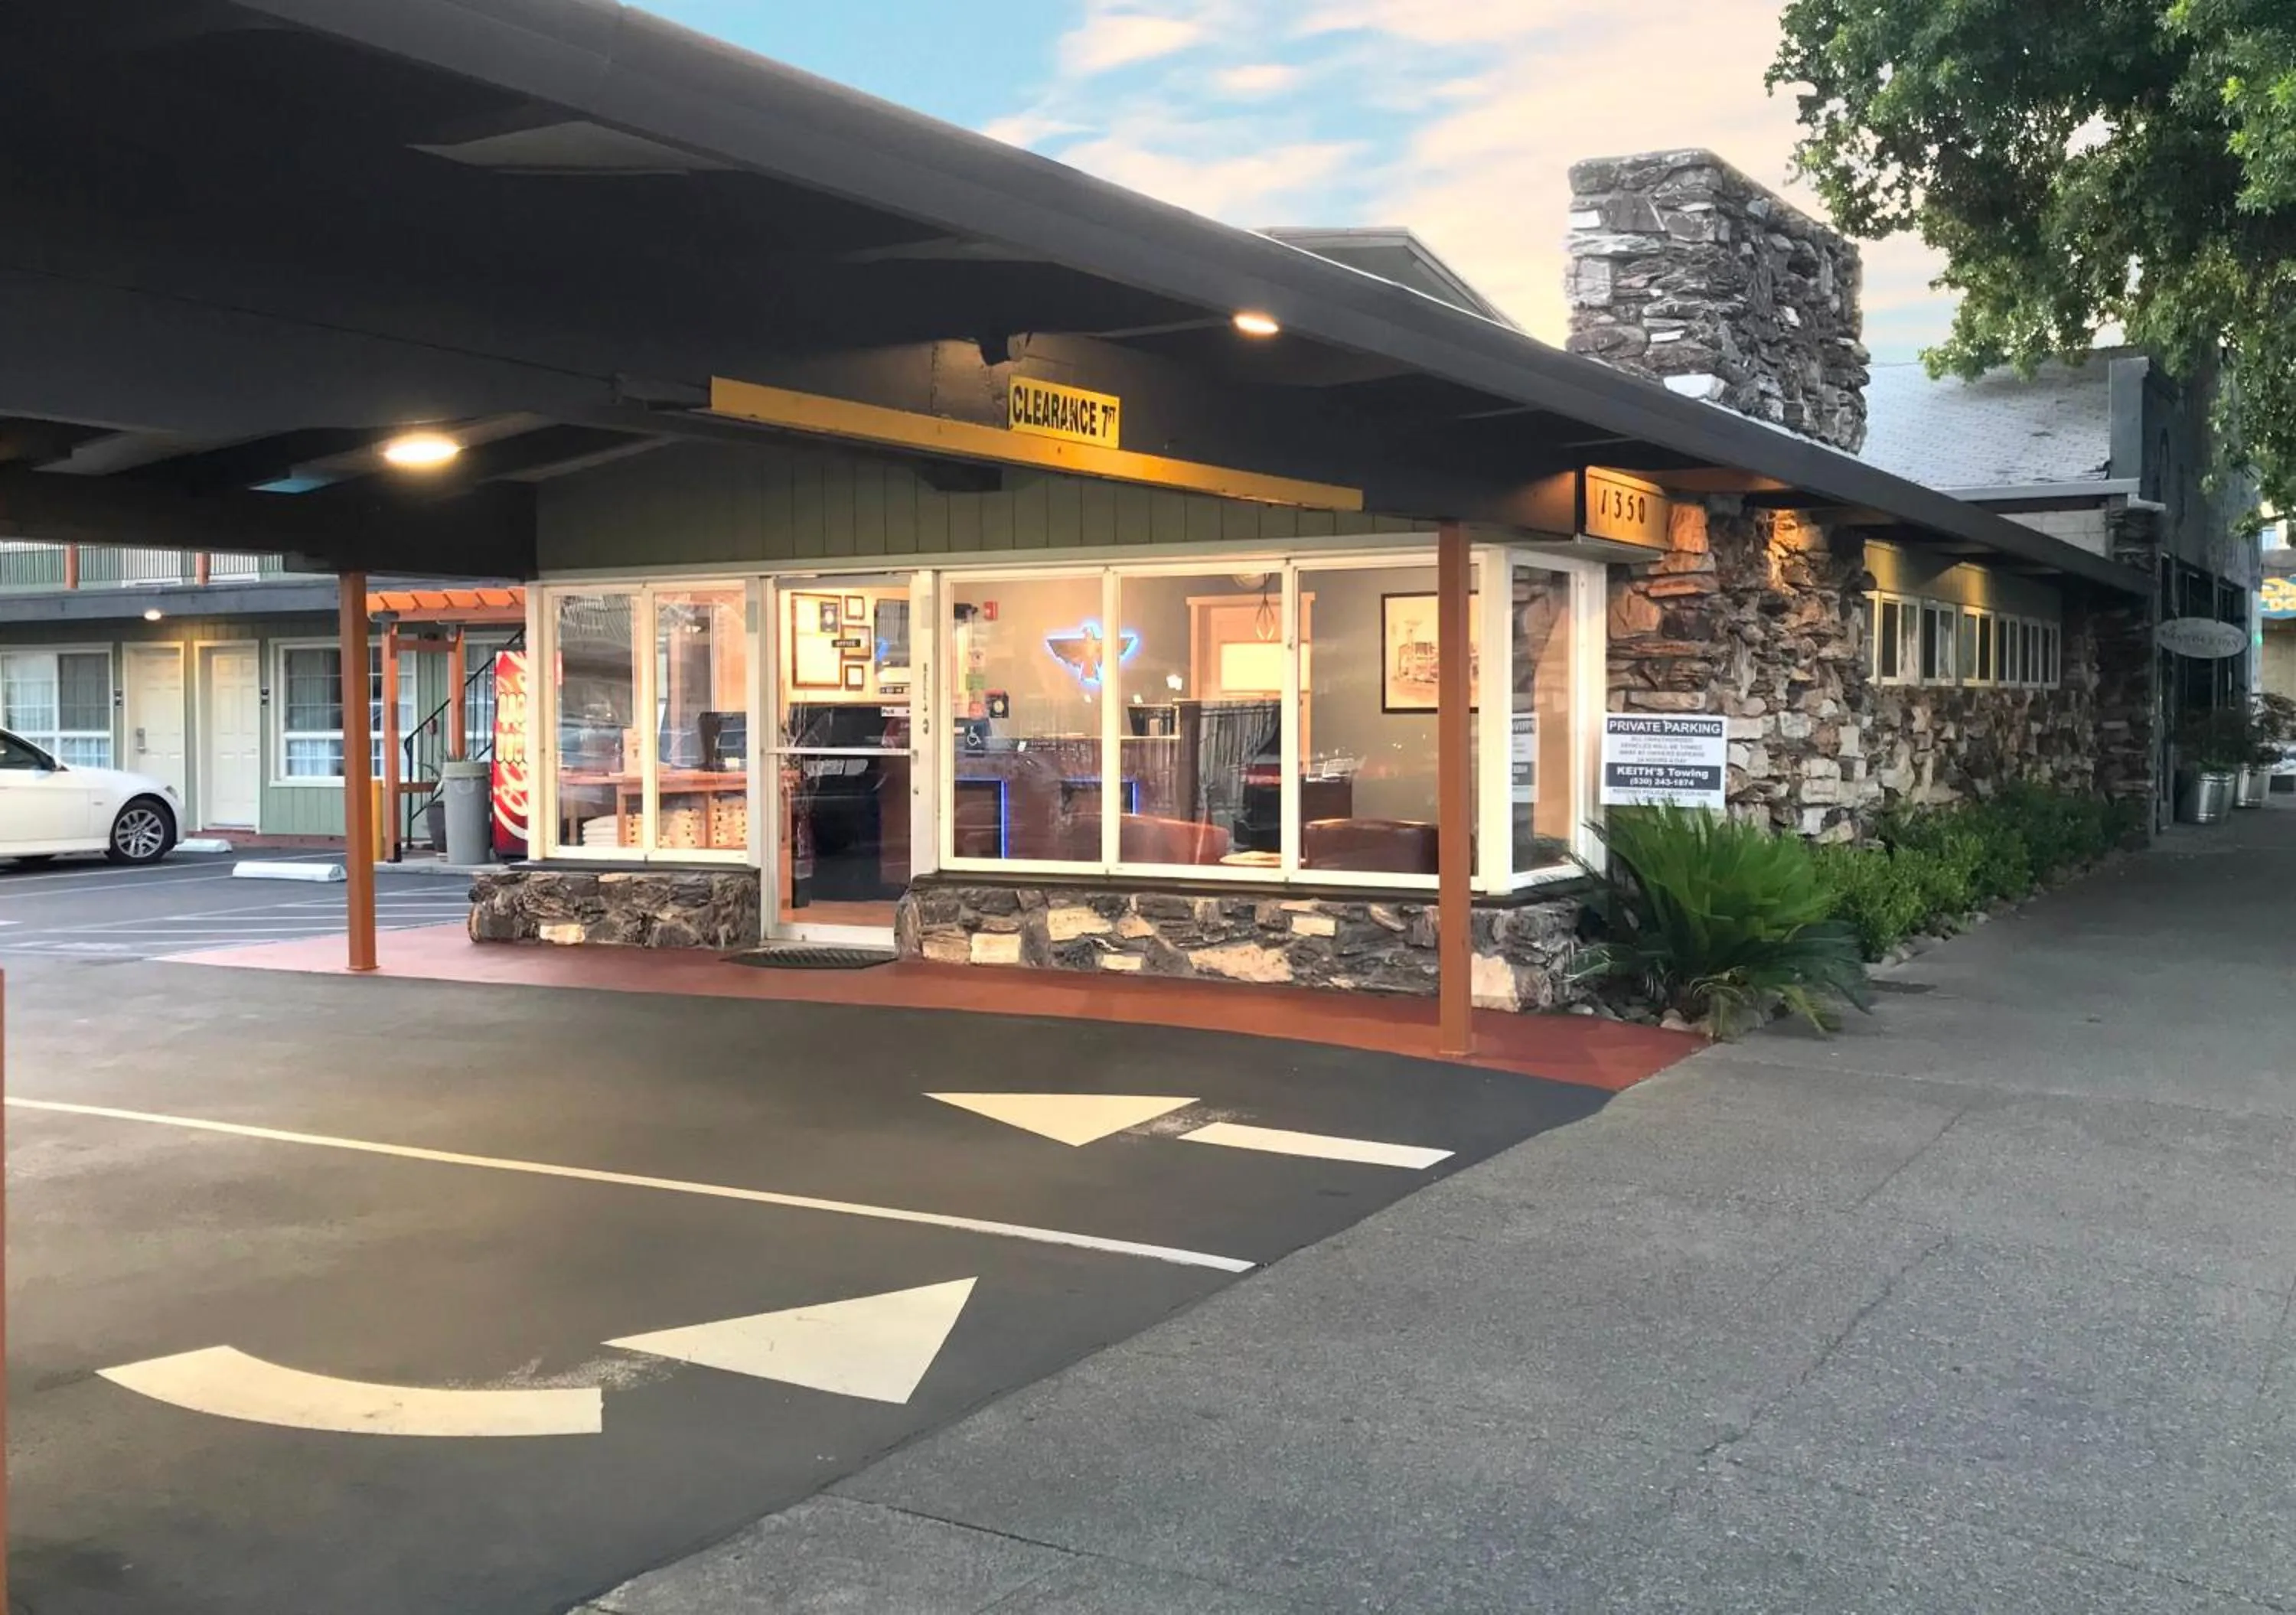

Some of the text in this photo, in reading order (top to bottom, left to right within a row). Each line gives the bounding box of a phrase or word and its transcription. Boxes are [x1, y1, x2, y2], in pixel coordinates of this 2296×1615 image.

[1013, 385, 1097, 436] CLEARANCE
[1601, 489, 1645, 524] 1350
[1609, 720, 1721, 734] PRIVATE PARKING
[1616, 766, 1709, 780] KEITH'S Towing
[1629, 777, 1652, 786] (530)
